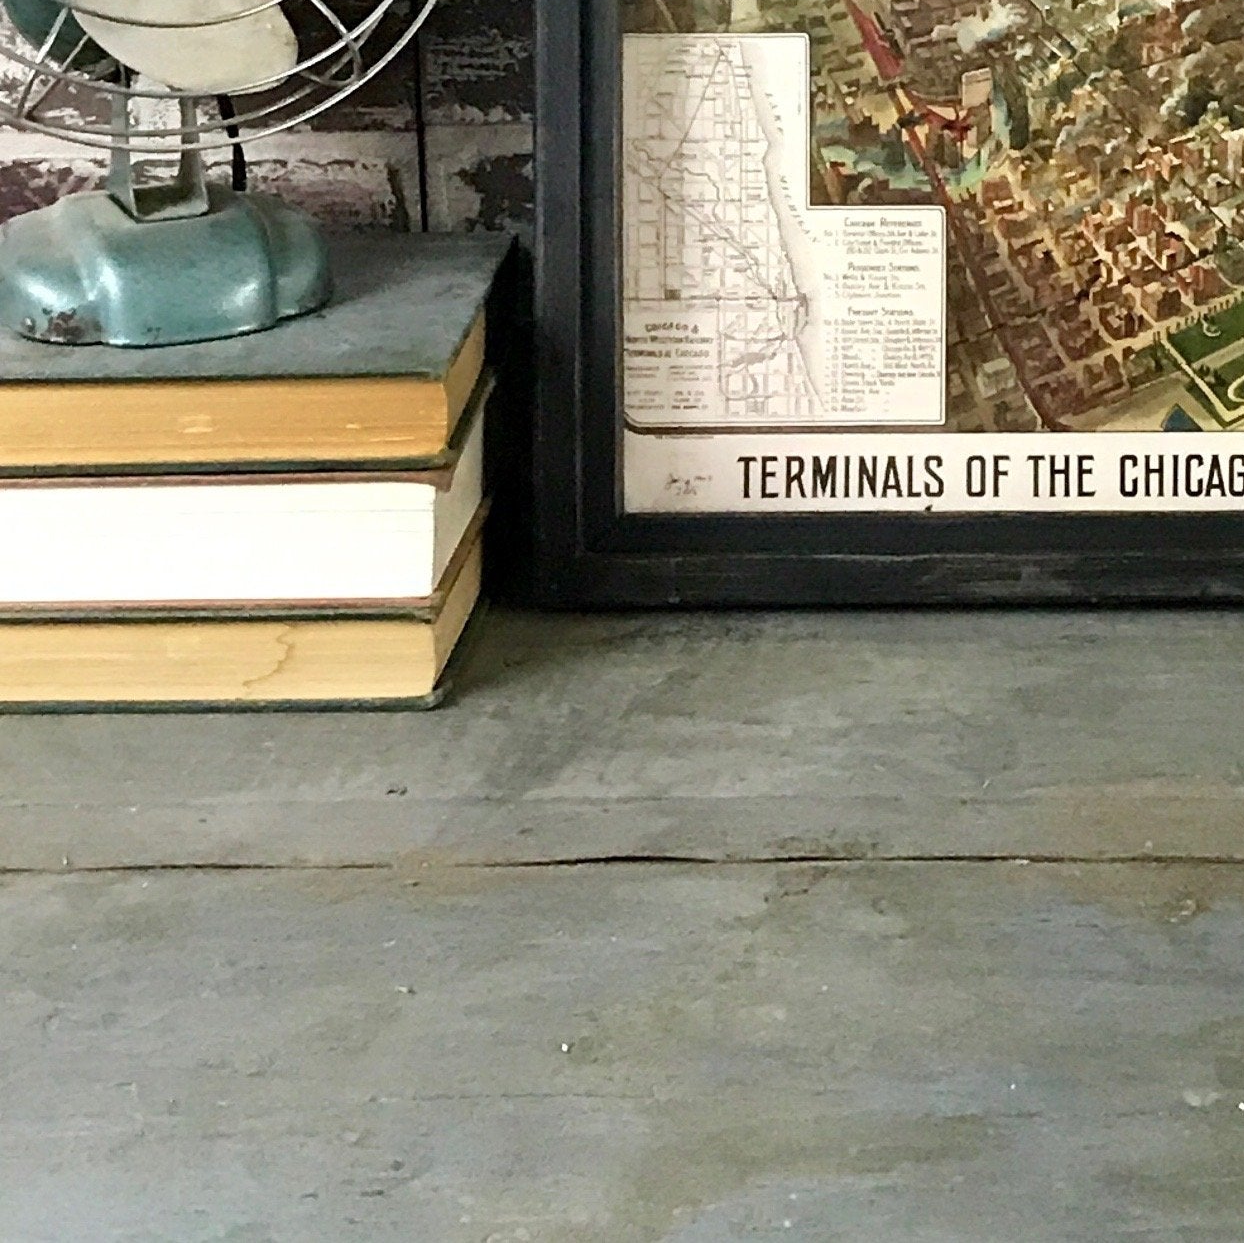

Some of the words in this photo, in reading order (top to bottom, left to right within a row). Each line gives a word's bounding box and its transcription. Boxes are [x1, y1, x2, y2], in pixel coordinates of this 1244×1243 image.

[738, 456, 943, 498] TERMINALS
[967, 456, 1009, 497] OF
[1028, 455, 1095, 497] THE
